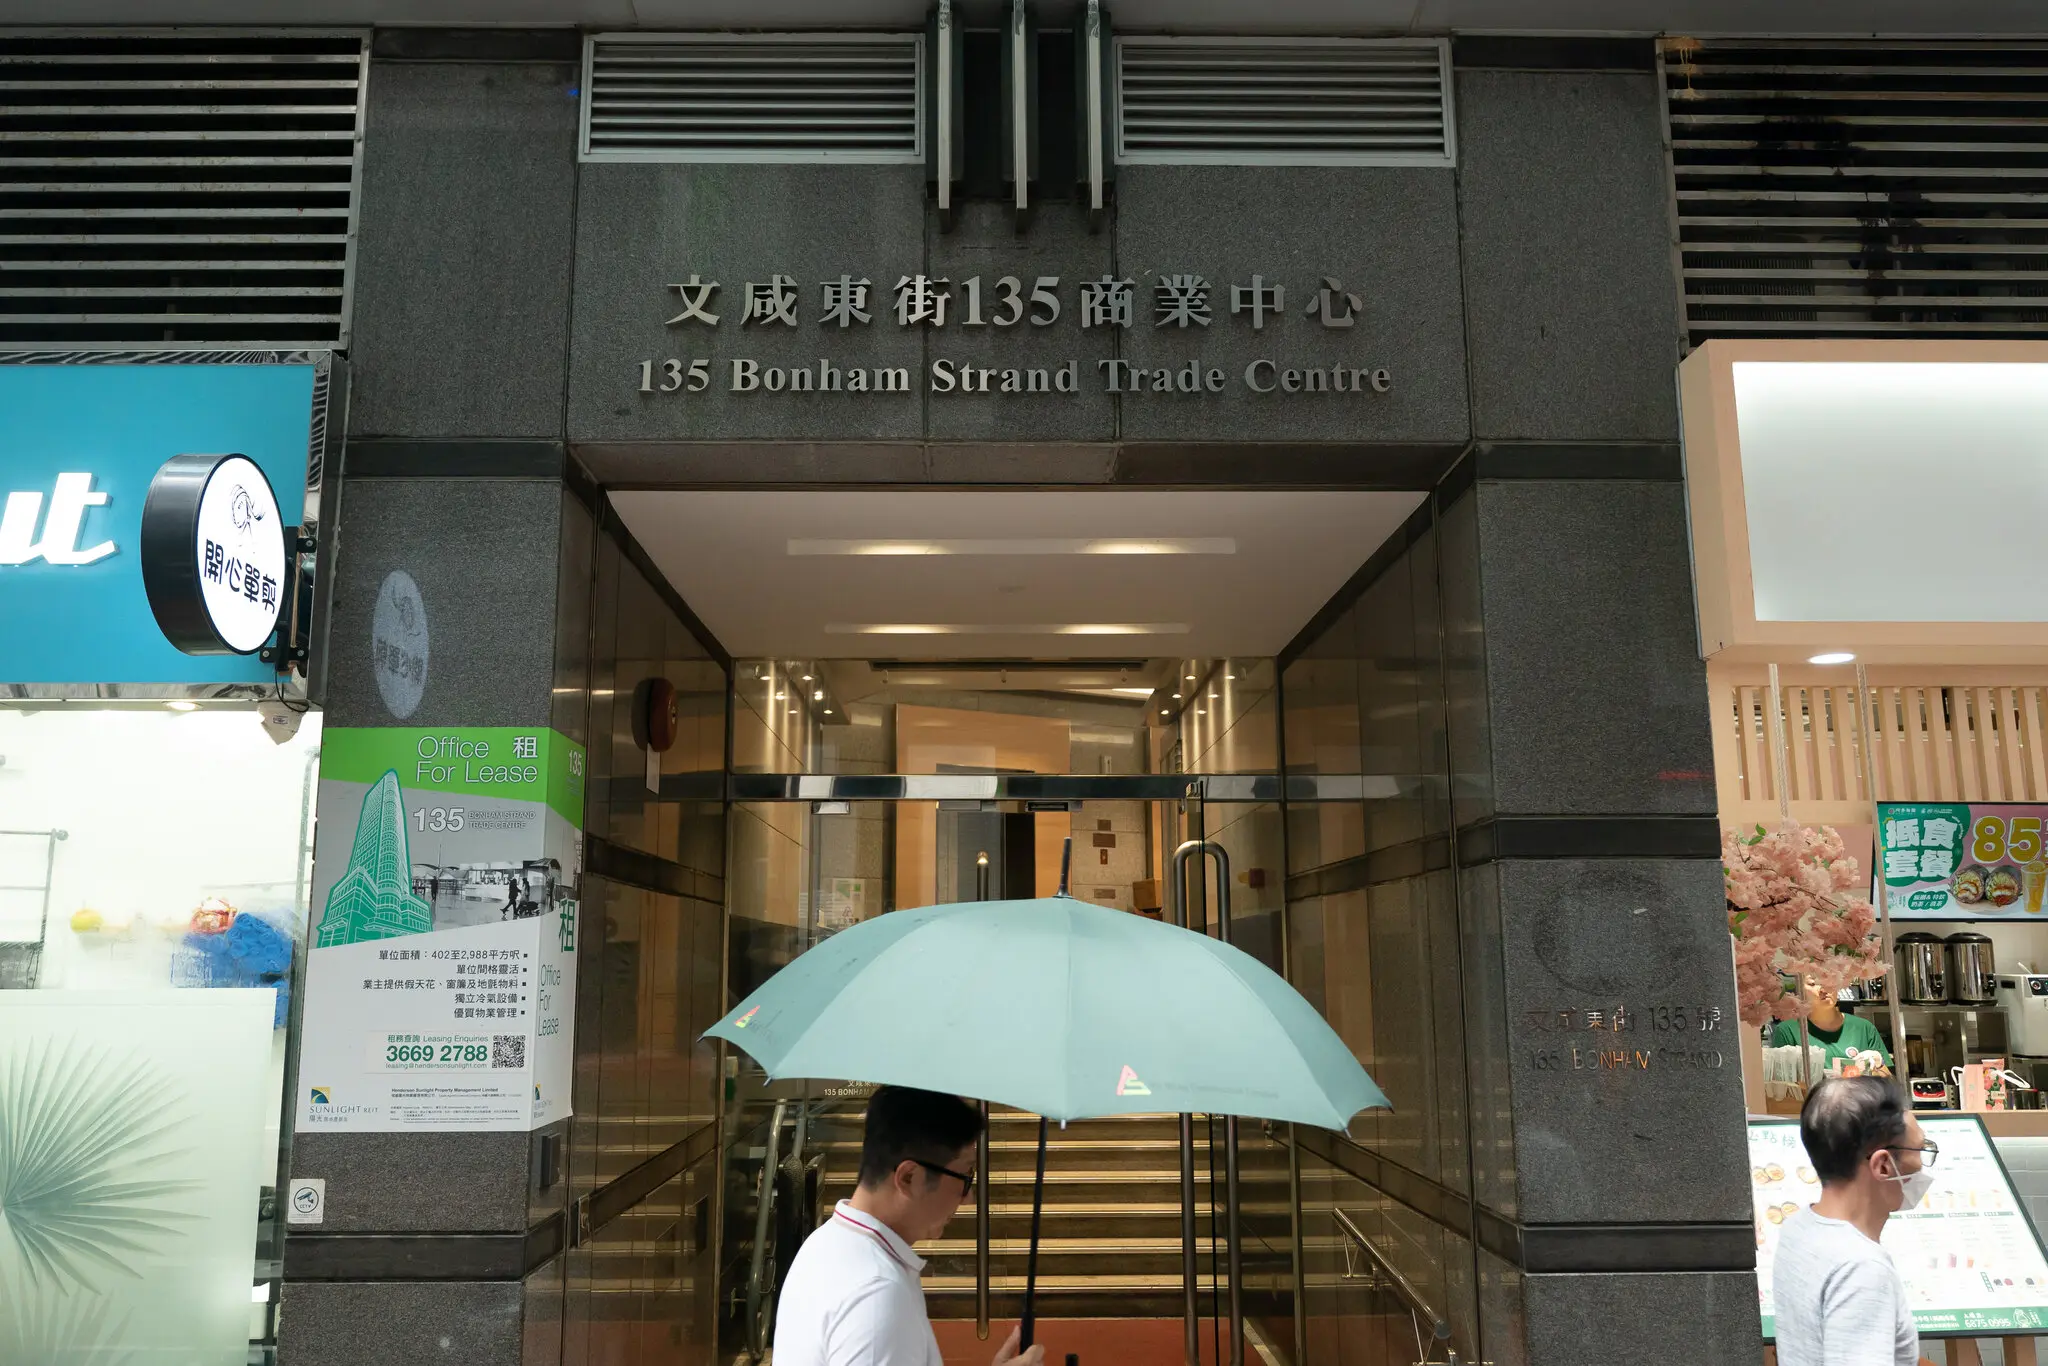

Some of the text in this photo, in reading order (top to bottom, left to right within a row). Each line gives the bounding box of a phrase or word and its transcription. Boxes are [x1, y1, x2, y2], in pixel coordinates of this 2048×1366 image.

[637, 358, 1392, 393] 135 Bonham Strand Trade Centre
[203, 538, 277, 615] 開心單剪
[417, 736, 489, 759] Office
[512, 736, 539, 759] 租
[416, 760, 538, 783] For Lease
[568, 749, 582, 777] 135
[413, 807, 465, 832] 135
[468, 811, 536, 819] BONHAM STRAND
[468, 821, 526, 829] TRADE CENTRE
[1972, 815, 2042, 864] 85
[1885, 850, 1953, 878] 套餐
[559, 898, 576, 953] 租
[540, 964, 561, 987] Office
[539, 990, 551, 1011] For
[538, 1015, 559, 1037] Lease
[1651, 1006, 1688, 1032] 135
[423, 1035, 452, 1045] Leasing
[386, 1045, 488, 1062] 3669 2788
[824, 1088, 837, 1096] 135
[310, 1105, 361, 1114] SUNLIGHT
